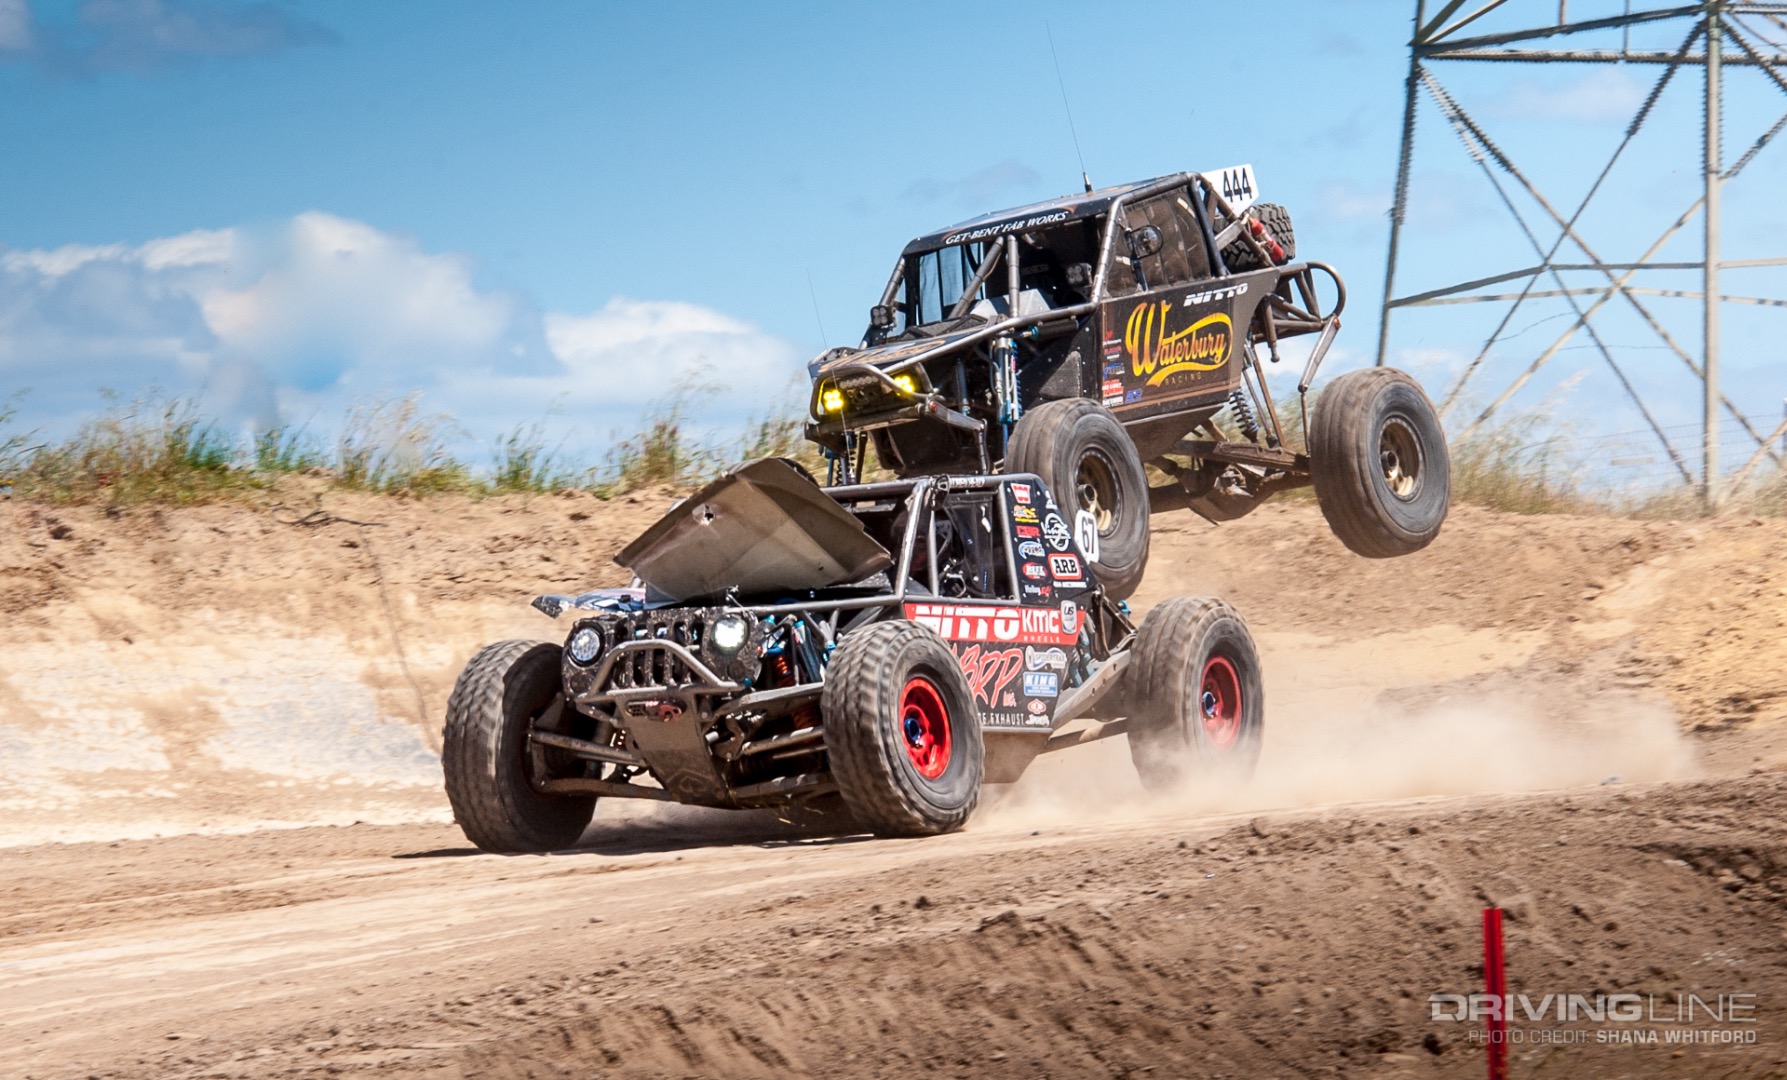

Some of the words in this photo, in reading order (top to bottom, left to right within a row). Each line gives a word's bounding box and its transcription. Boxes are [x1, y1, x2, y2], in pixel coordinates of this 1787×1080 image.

[1223, 167, 1253, 203] 444
[1027, 211, 1070, 227] WORKS
[1183, 283, 1248, 307] NITTO
[1125, 300, 1230, 380] Waterbury
[1165, 373, 1202, 386] RACING
[1081, 515, 1095, 555] 67
[1053, 559, 1078, 574] ARB
[915, 605, 1020, 640] NITTO
[1025, 674, 1056, 687] KING
[990, 712, 1025, 726] EXHAUST
